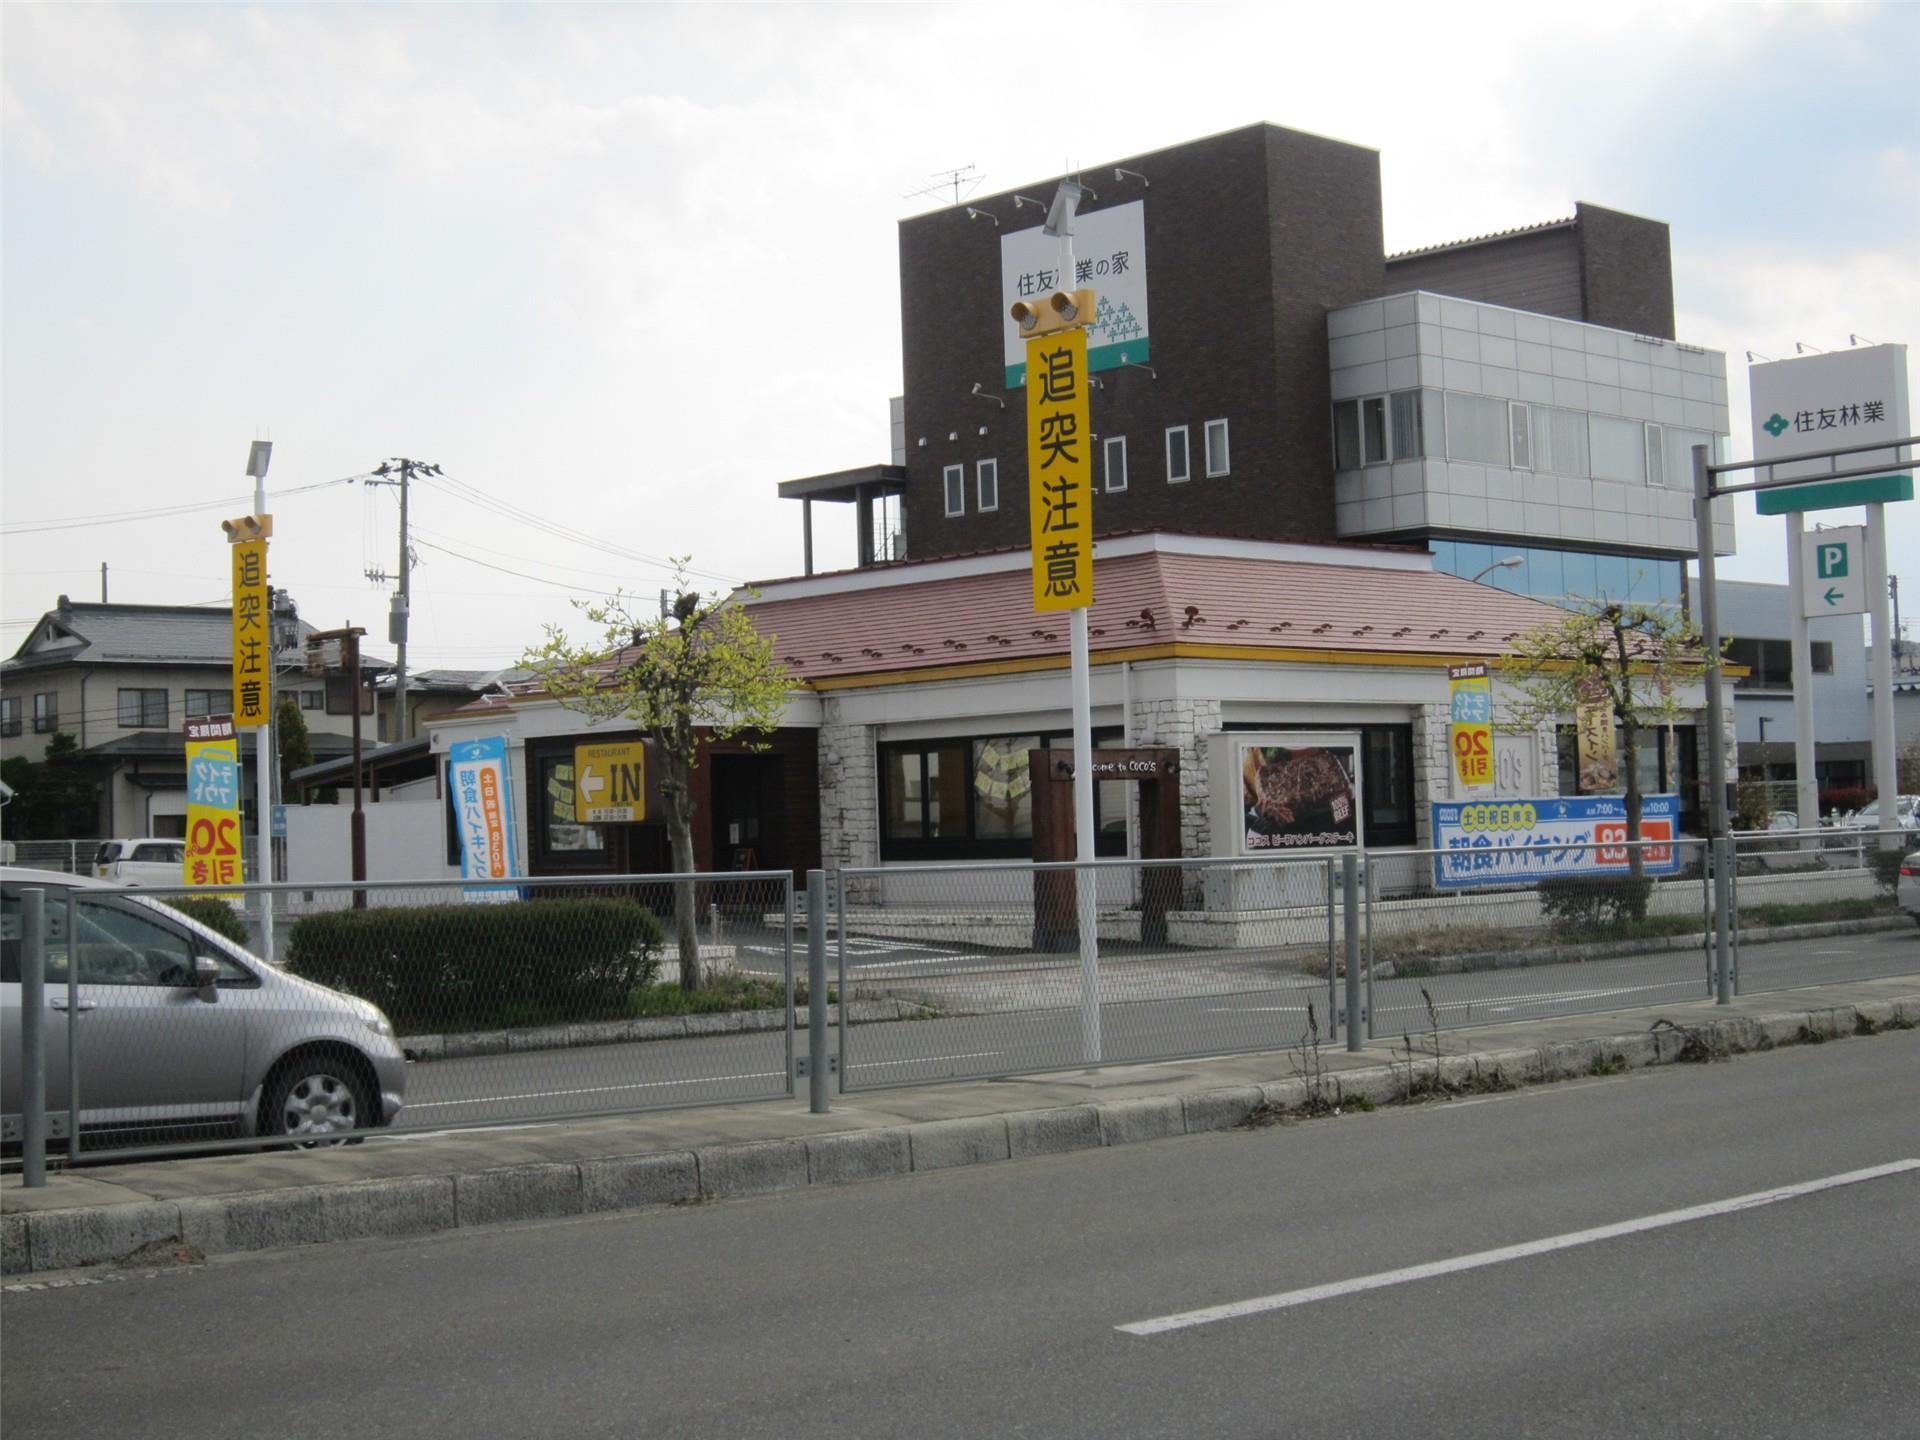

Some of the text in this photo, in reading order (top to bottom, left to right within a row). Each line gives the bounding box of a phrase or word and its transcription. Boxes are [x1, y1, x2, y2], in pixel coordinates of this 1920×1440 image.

[1017, 251, 1130, 297] 住友業の家
[1793, 400, 1885, 434] 住友林業
[1039, 346, 1080, 598] 追突注意
[1824, 547, 1842, 576] P
[239, 550, 262, 718] 追突注意
[610, 762, 641, 802] IN
